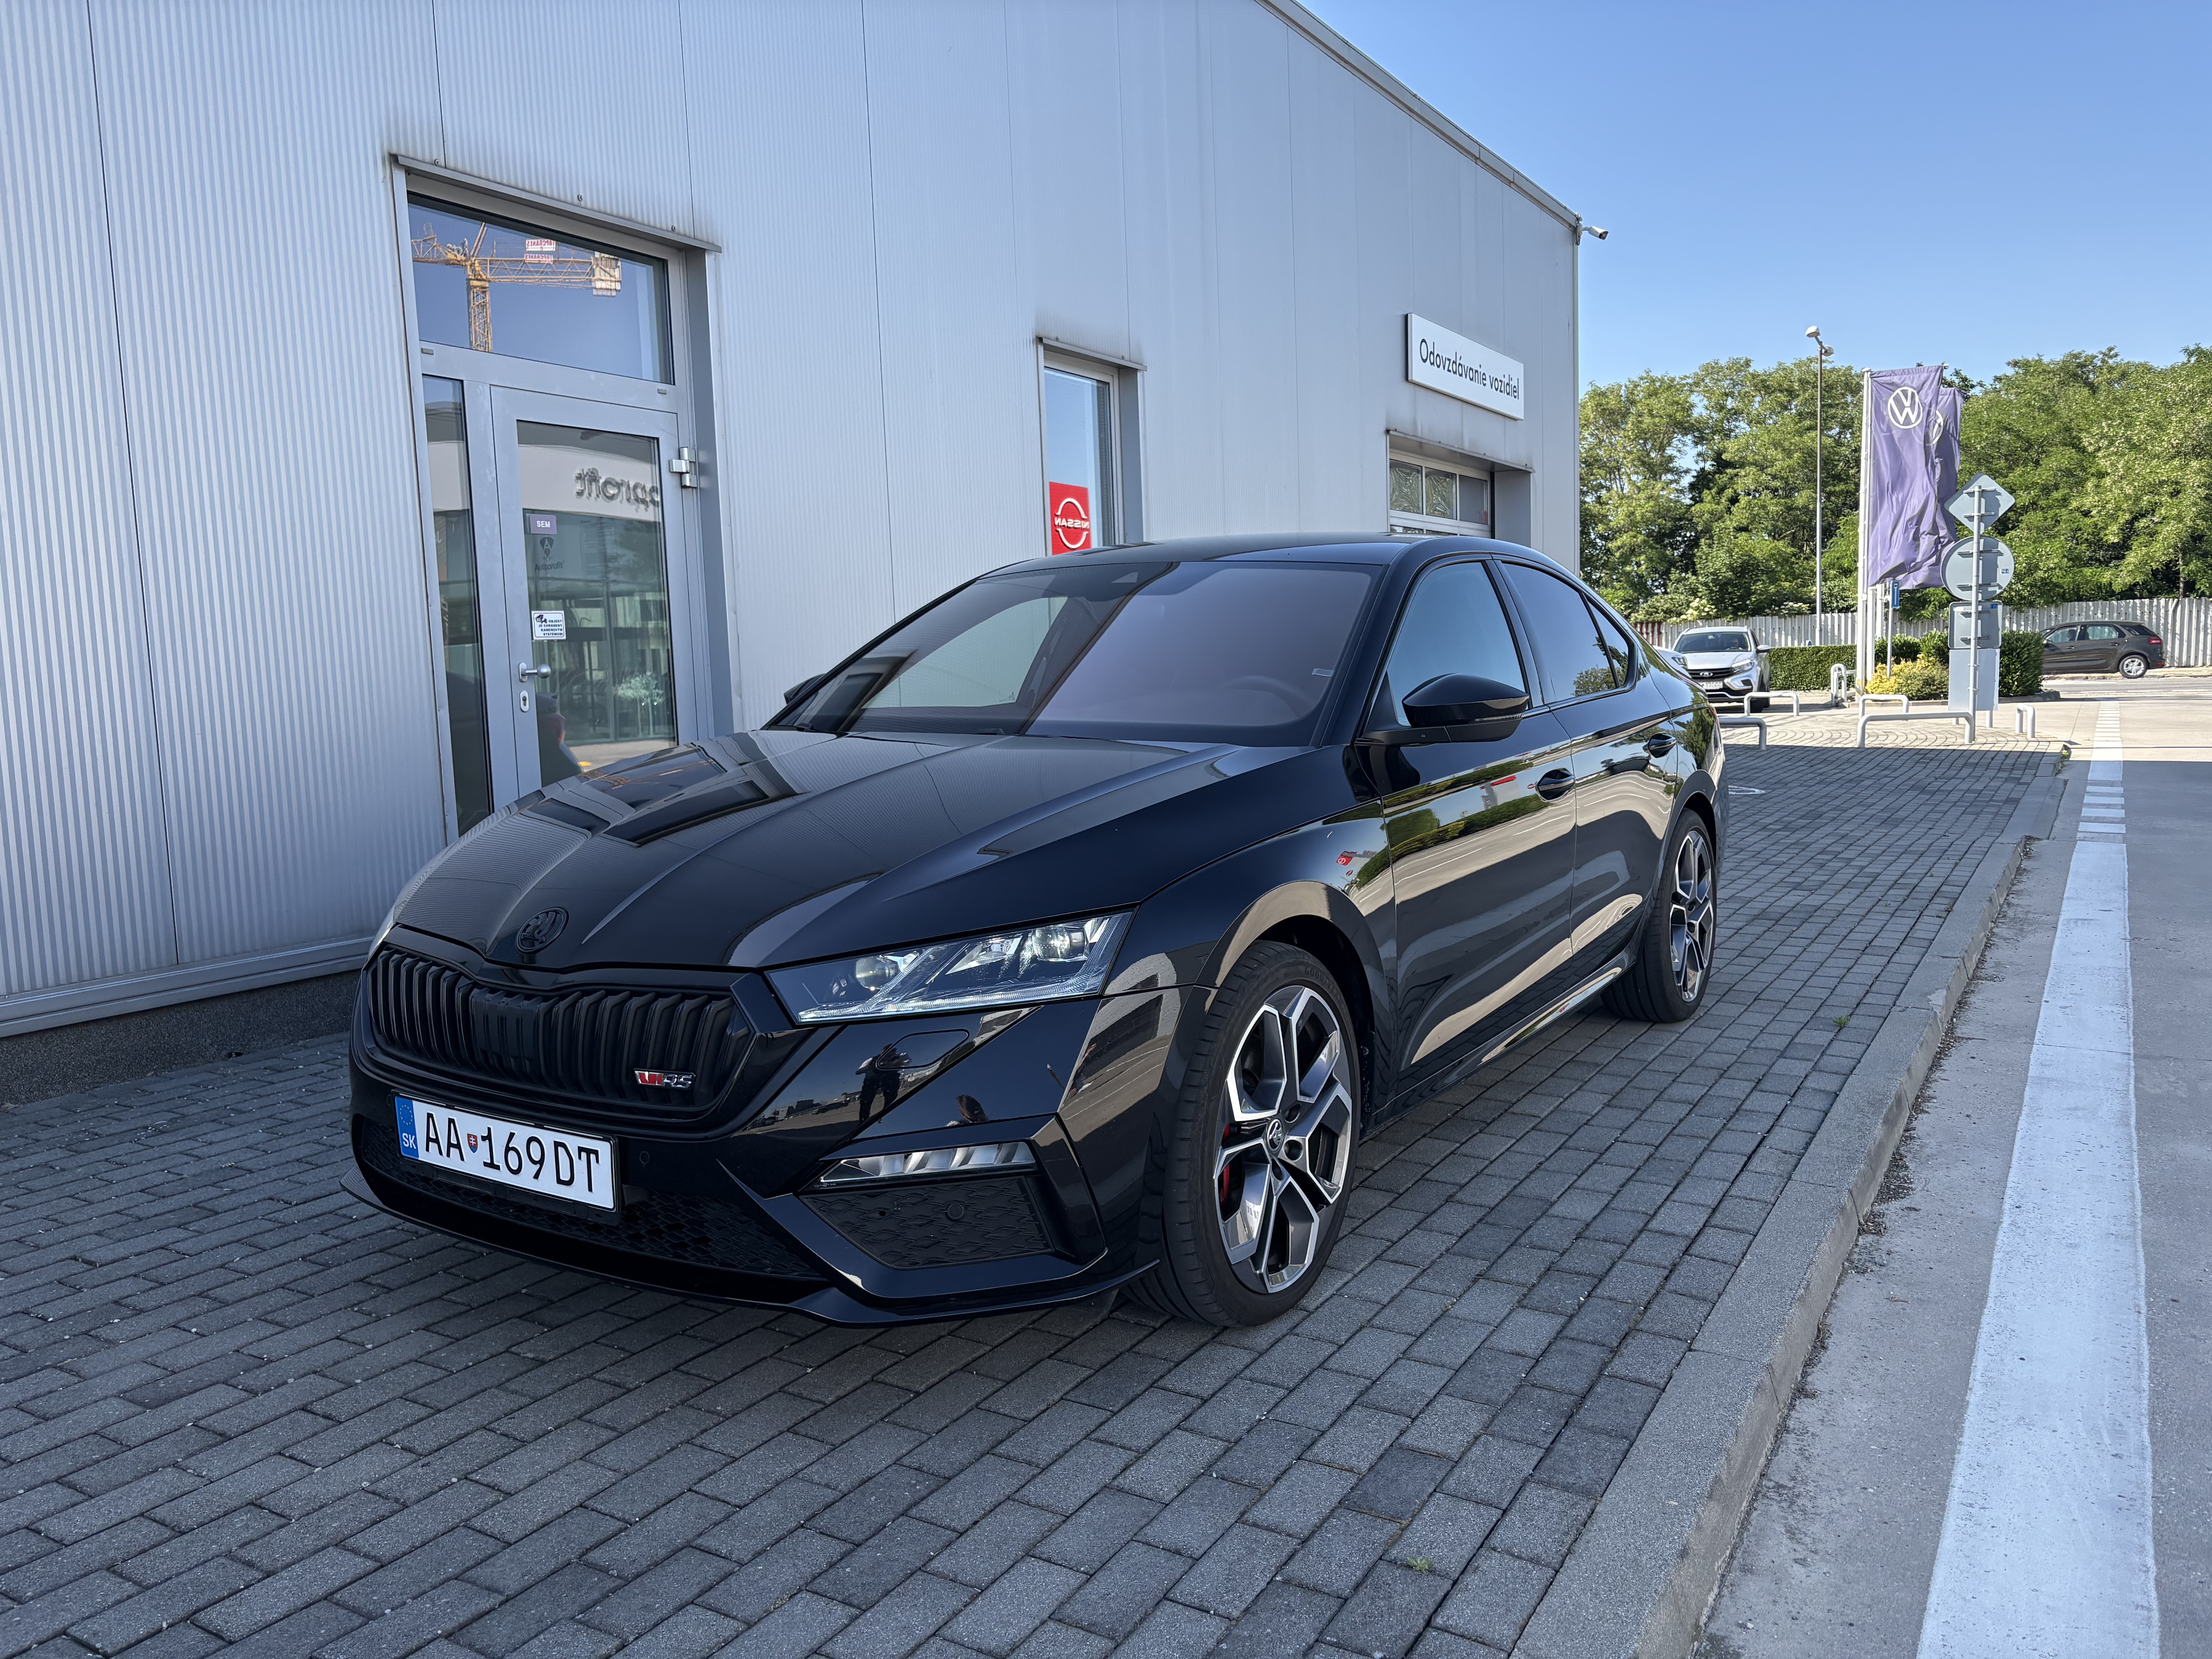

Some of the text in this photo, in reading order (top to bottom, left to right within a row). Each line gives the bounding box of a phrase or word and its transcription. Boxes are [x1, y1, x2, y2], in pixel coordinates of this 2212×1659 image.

[1419, 338, 1520, 400] Odovzdávanie vozidiel
[402, 1132, 417, 1150] SK
